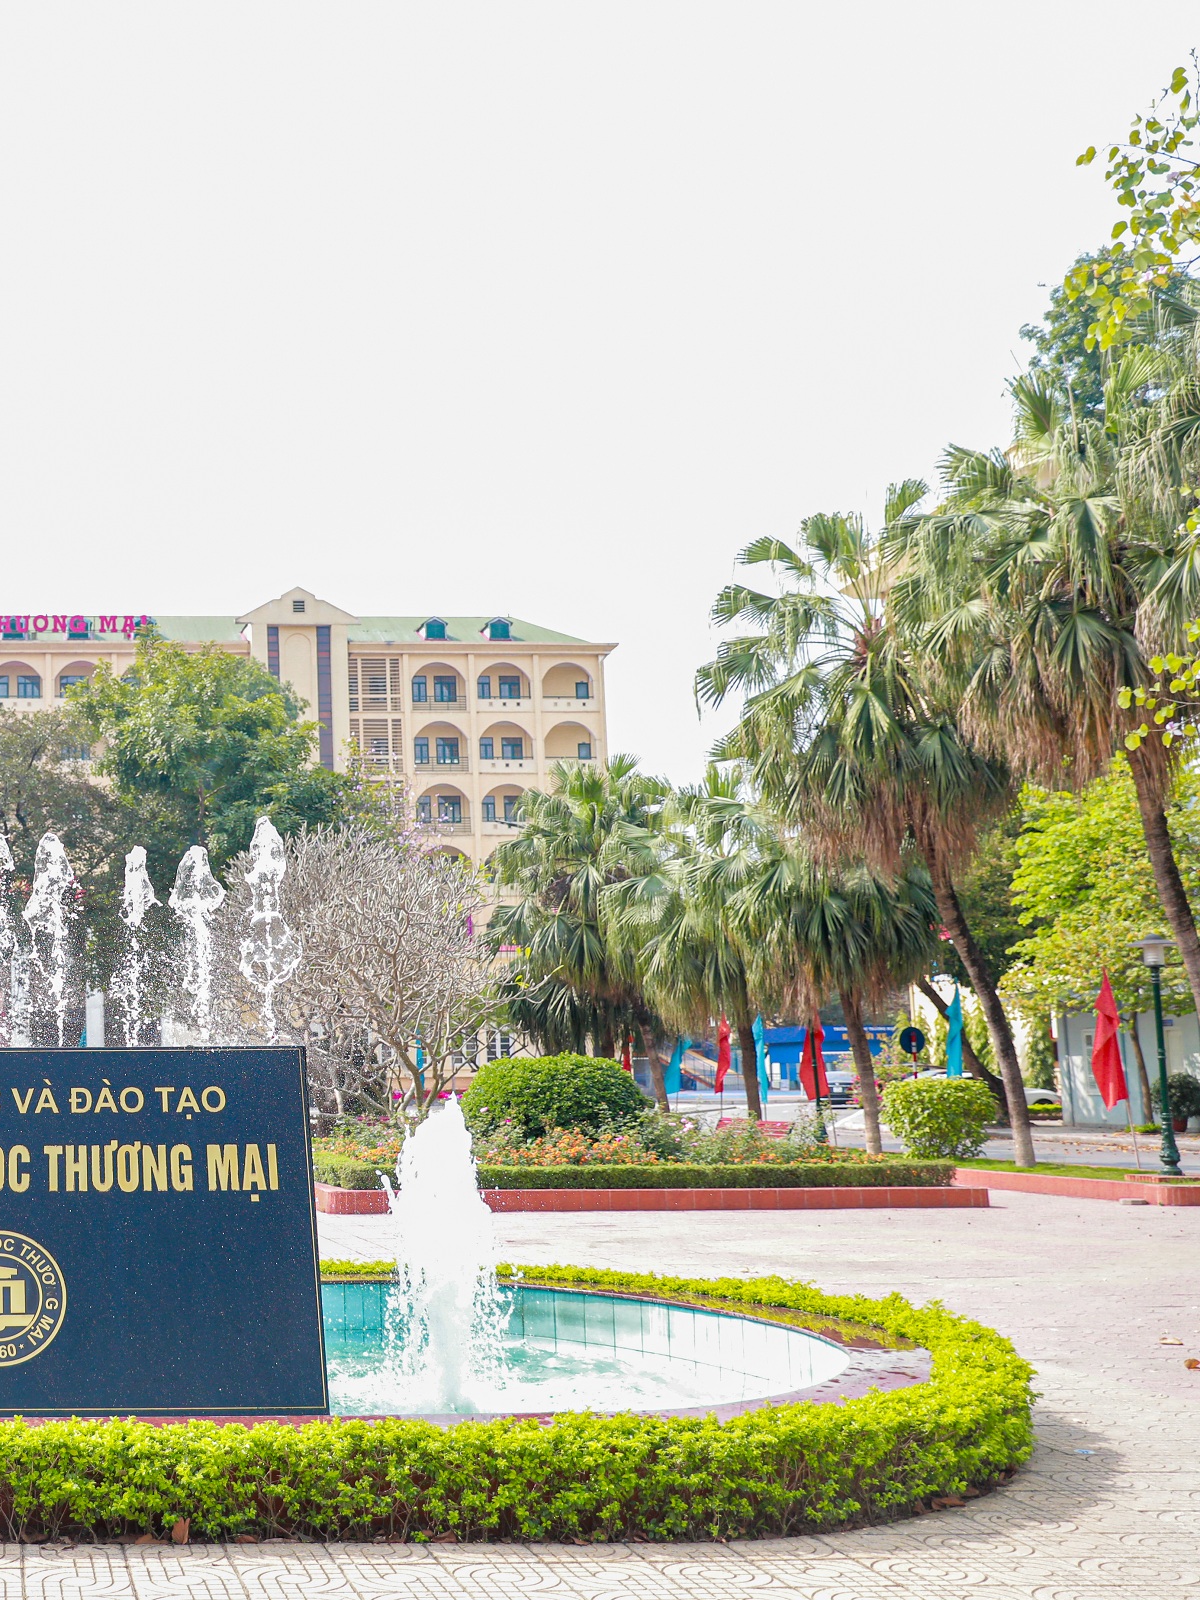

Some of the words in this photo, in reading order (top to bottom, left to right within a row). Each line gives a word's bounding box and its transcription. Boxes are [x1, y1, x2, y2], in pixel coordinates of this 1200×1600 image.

[11, 1079, 60, 1114] VÀ
[68, 1079, 145, 1114] ĐÀO
[154, 1086, 226, 1120] TẠO
[43, 1140, 194, 1193] THƯƠNG
[206, 1143, 279, 1203] MẠI
[20, 1243, 59, 1310] THƯƠG
[27, 1314, 54, 1346] MẠI
